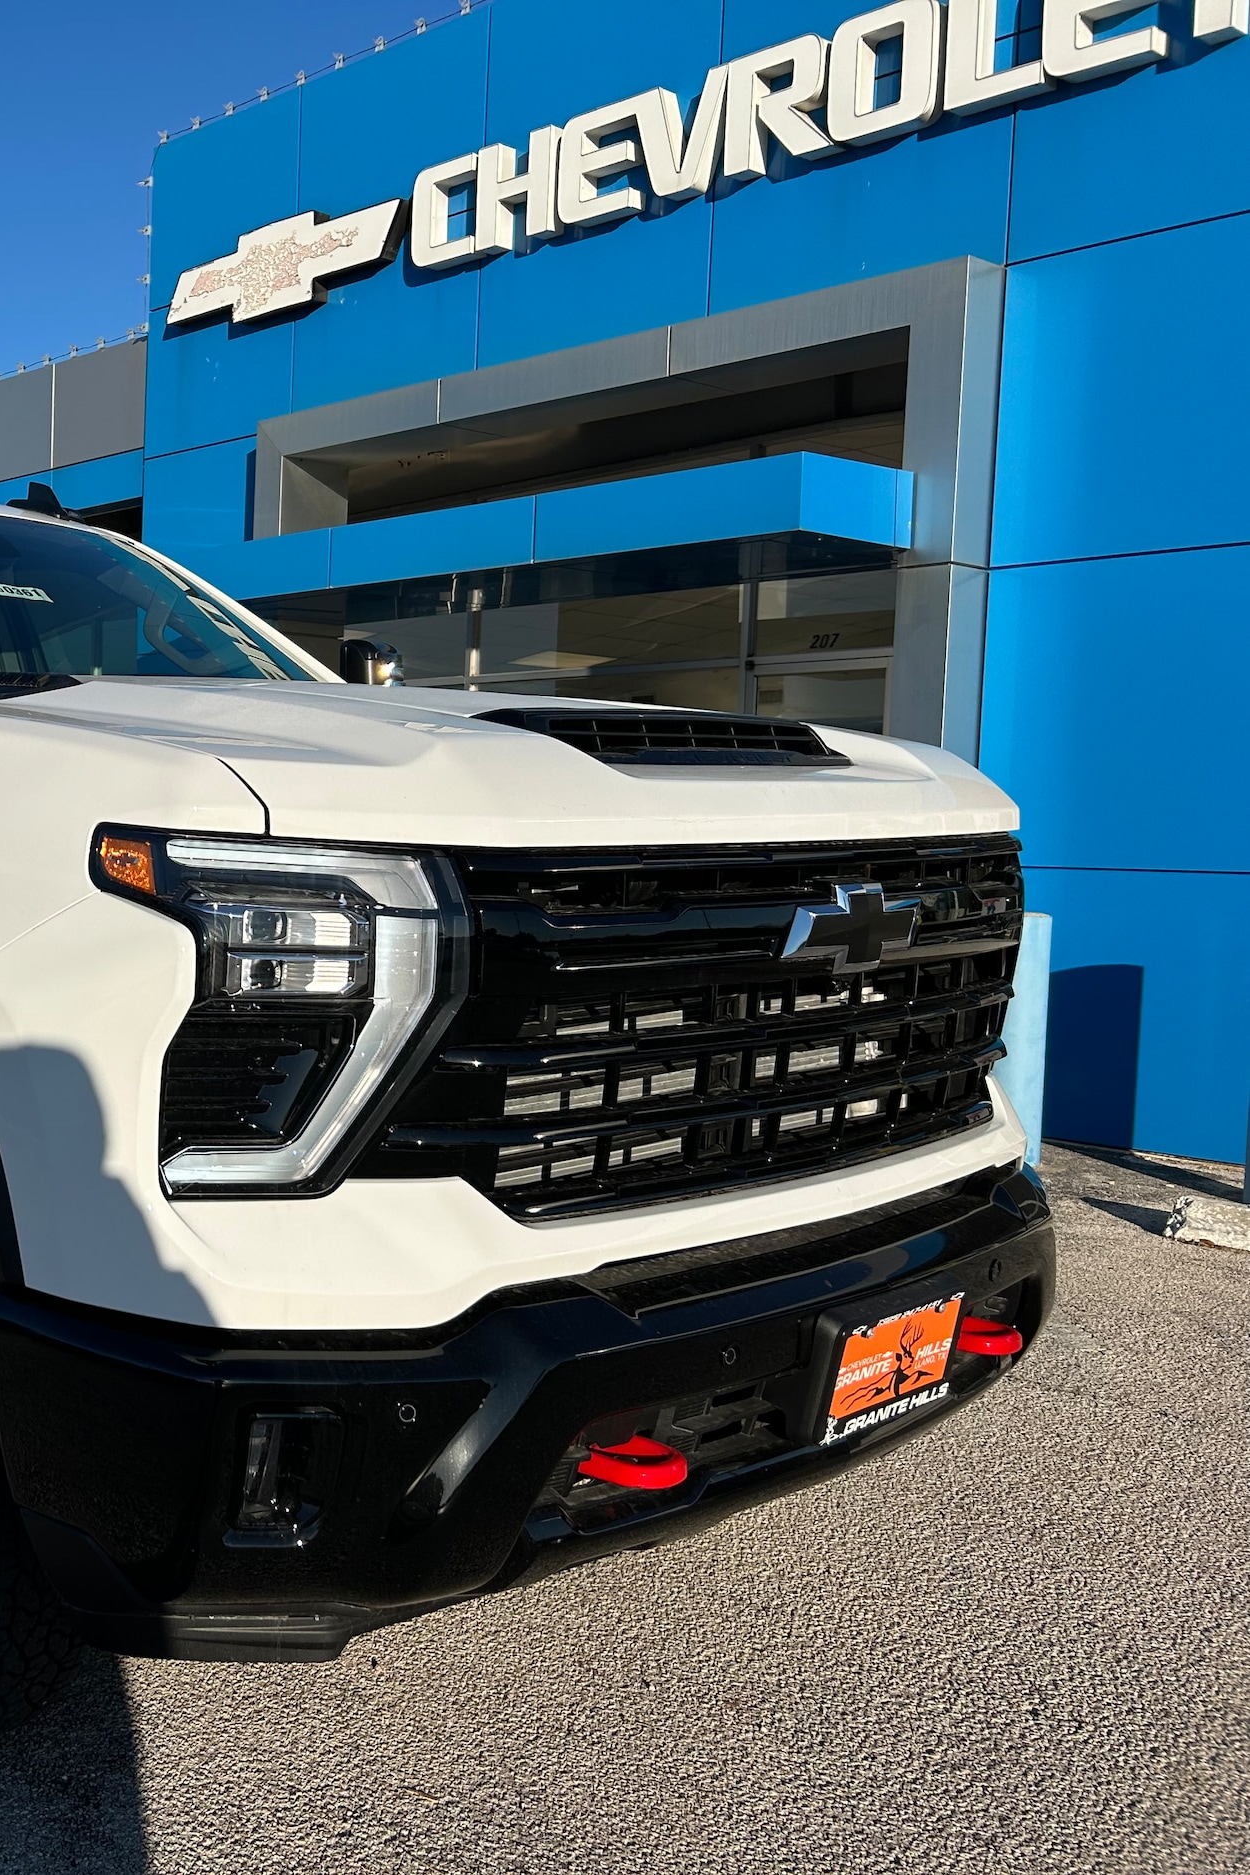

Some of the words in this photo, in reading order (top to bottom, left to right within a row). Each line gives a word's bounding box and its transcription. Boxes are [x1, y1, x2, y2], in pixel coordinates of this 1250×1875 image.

[809, 633, 840, 649] 207
[915, 1337, 953, 1361] HILLS
[846, 1353, 882, 1371] CHEVROLET
[843, 1398, 910, 1435] GRANITE
[909, 1382, 950, 1410] HILLS
